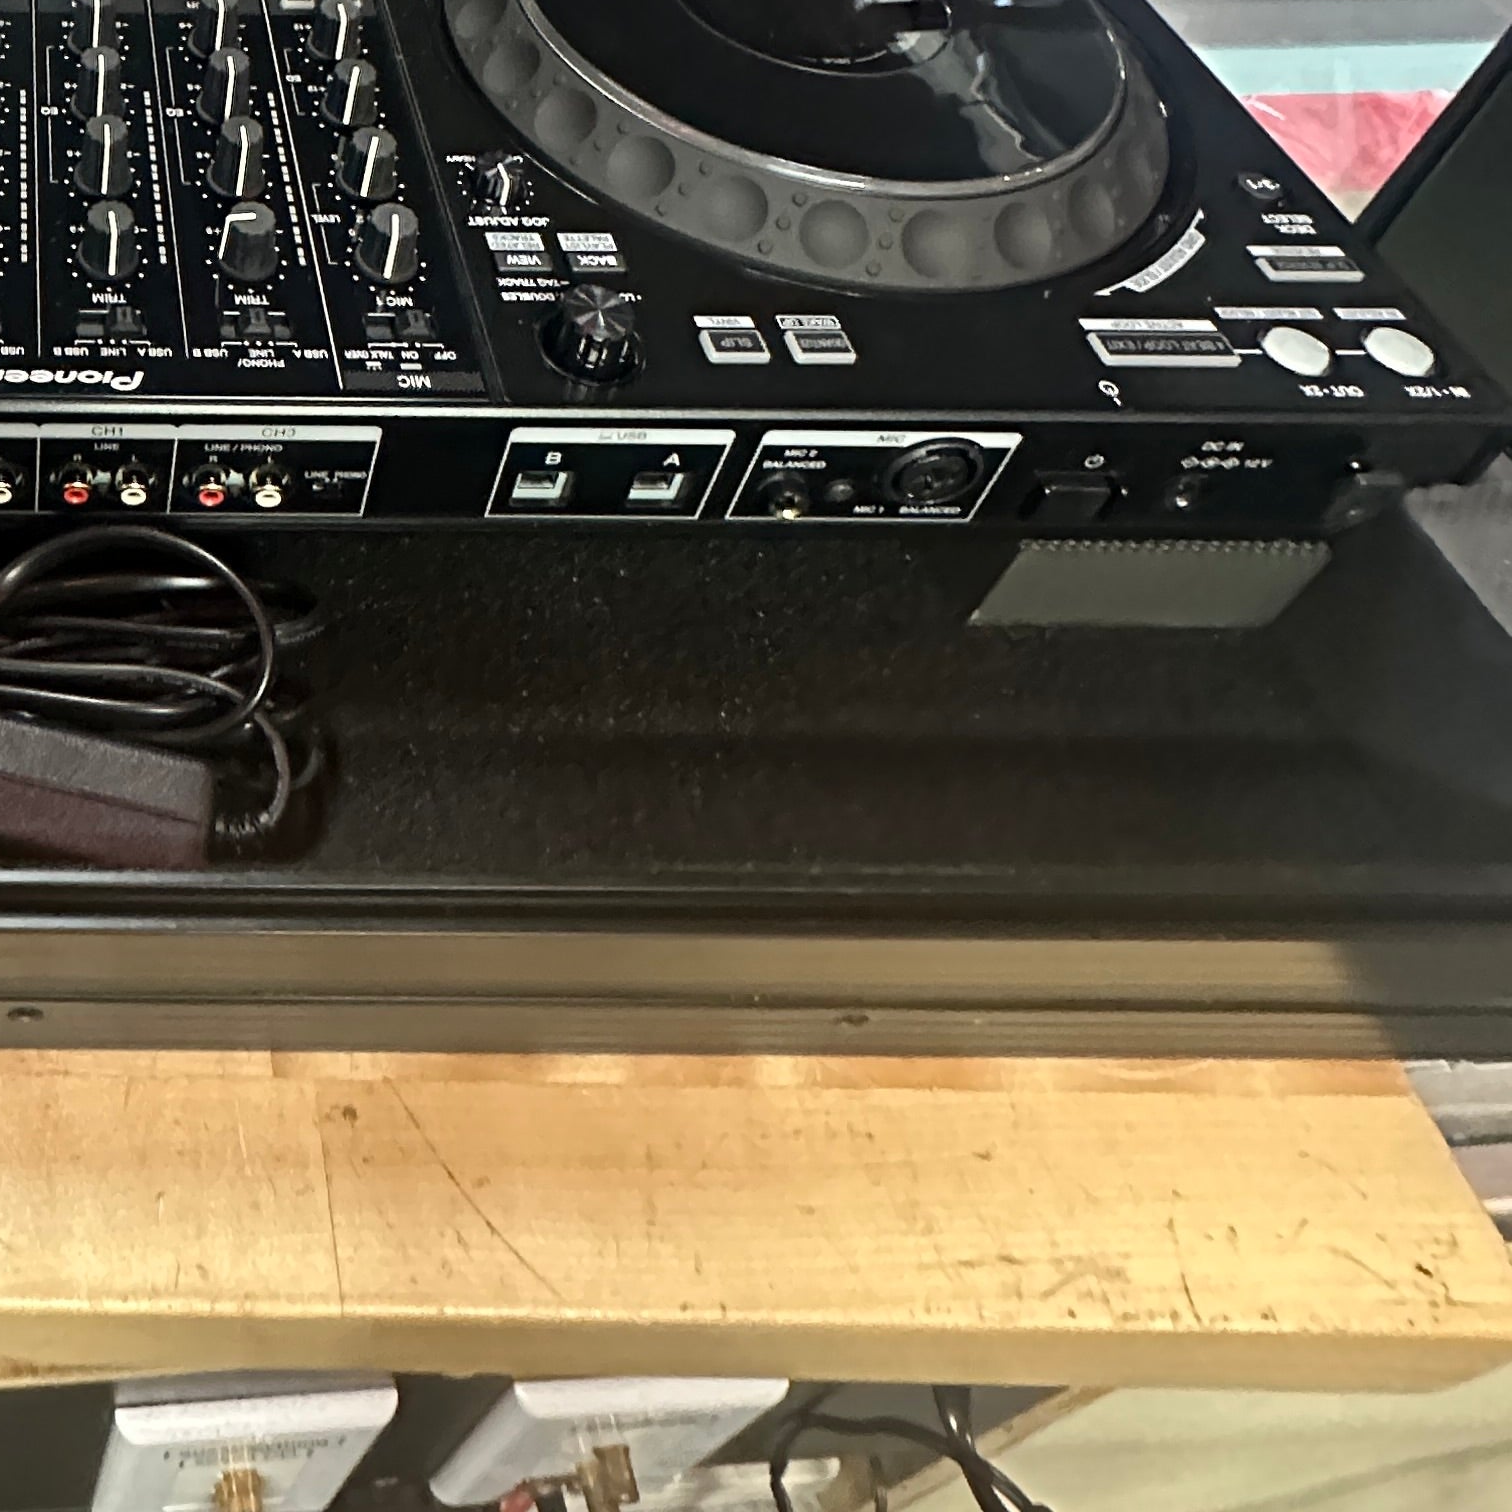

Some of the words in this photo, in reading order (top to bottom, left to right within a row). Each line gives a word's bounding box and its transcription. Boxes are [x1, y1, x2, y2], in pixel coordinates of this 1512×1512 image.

[311, 214, 341, 223] LEVEL
[467, 216, 519, 226] ADJUST
[521, 216, 549, 226] JOG
[507, 255, 541, 265] VIEW
[577, 255, 616, 266] BACK
[497, 278, 534, 287] TRACK
[92, 292, 126, 303] TRIM
[234, 294, 269, 305] TRIM
[386, 296, 413, 307] MIC
[720, 336, 753, 348] SLIP
[65, 346, 89, 356] USB
[100, 347, 126, 356] LINE
[137, 347, 147, 356] A
[148, 347, 172, 357] USB
[204, 349, 229, 358] USB
[248, 348, 274, 358] LINE
[292, 349, 302, 357] A
[304, 349, 328, 358] USB
[401, 350, 419, 359] ON
[434, 350, 456, 360] OFF
[397, 374, 431, 388] MIC
[91, 426, 123, 436] CH1
[94, 443, 120, 451] LINE
[545, 452, 562, 465] B
[664, 452, 681, 466] A
[762, 460, 827, 470] BALANCED
